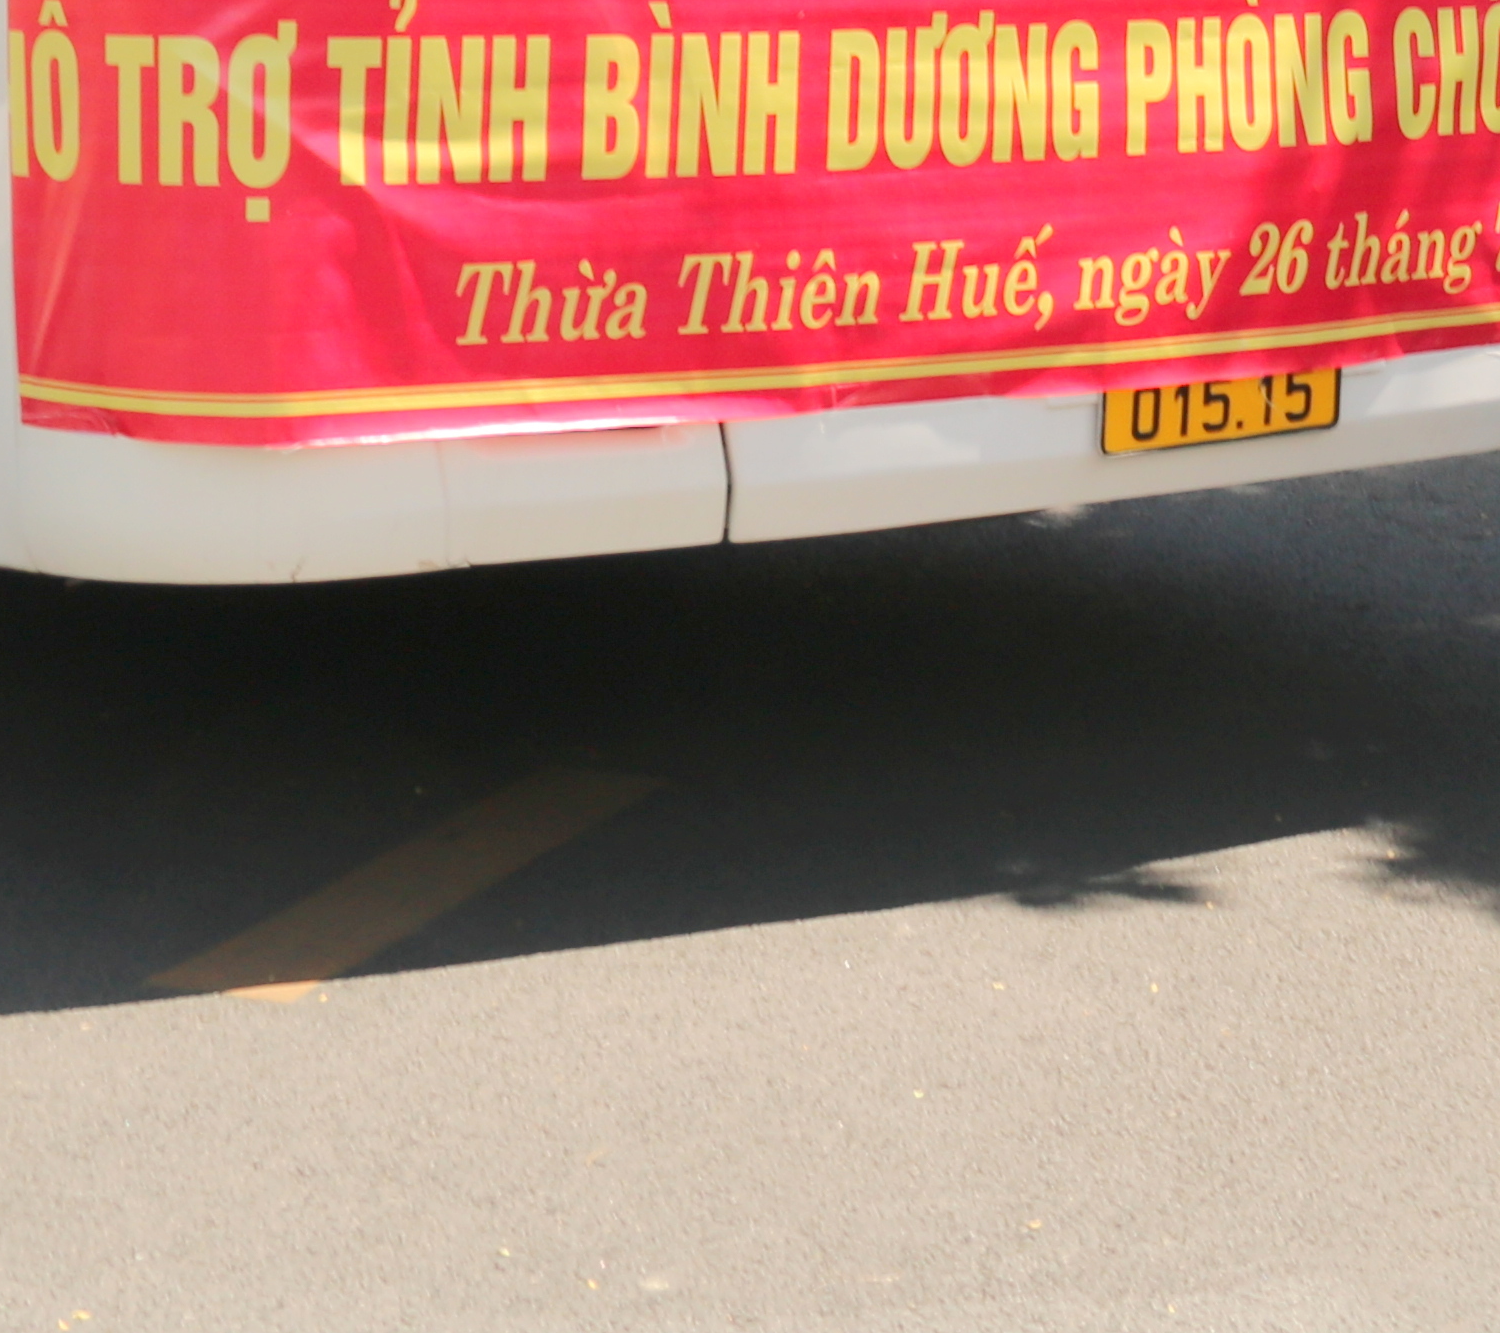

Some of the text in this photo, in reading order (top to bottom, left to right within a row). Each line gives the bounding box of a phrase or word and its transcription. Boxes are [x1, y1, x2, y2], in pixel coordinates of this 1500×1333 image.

[105, 20, 297, 222] TRỢ
[582, 1, 801, 179] BÌNH
[827, 10, 1101, 171] DƯƠNG
[456, 259, 648, 346] Thừa
[678, 249, 881, 335] Thiên
[900, 223, 1054, 331] Huế,
[1074, 227, 1231, 327] ngày
[1240, 220, 1315, 297] 26
[1324, 209, 1484, 296] tháng
[1132, 371, 1313, 442] 015.15
